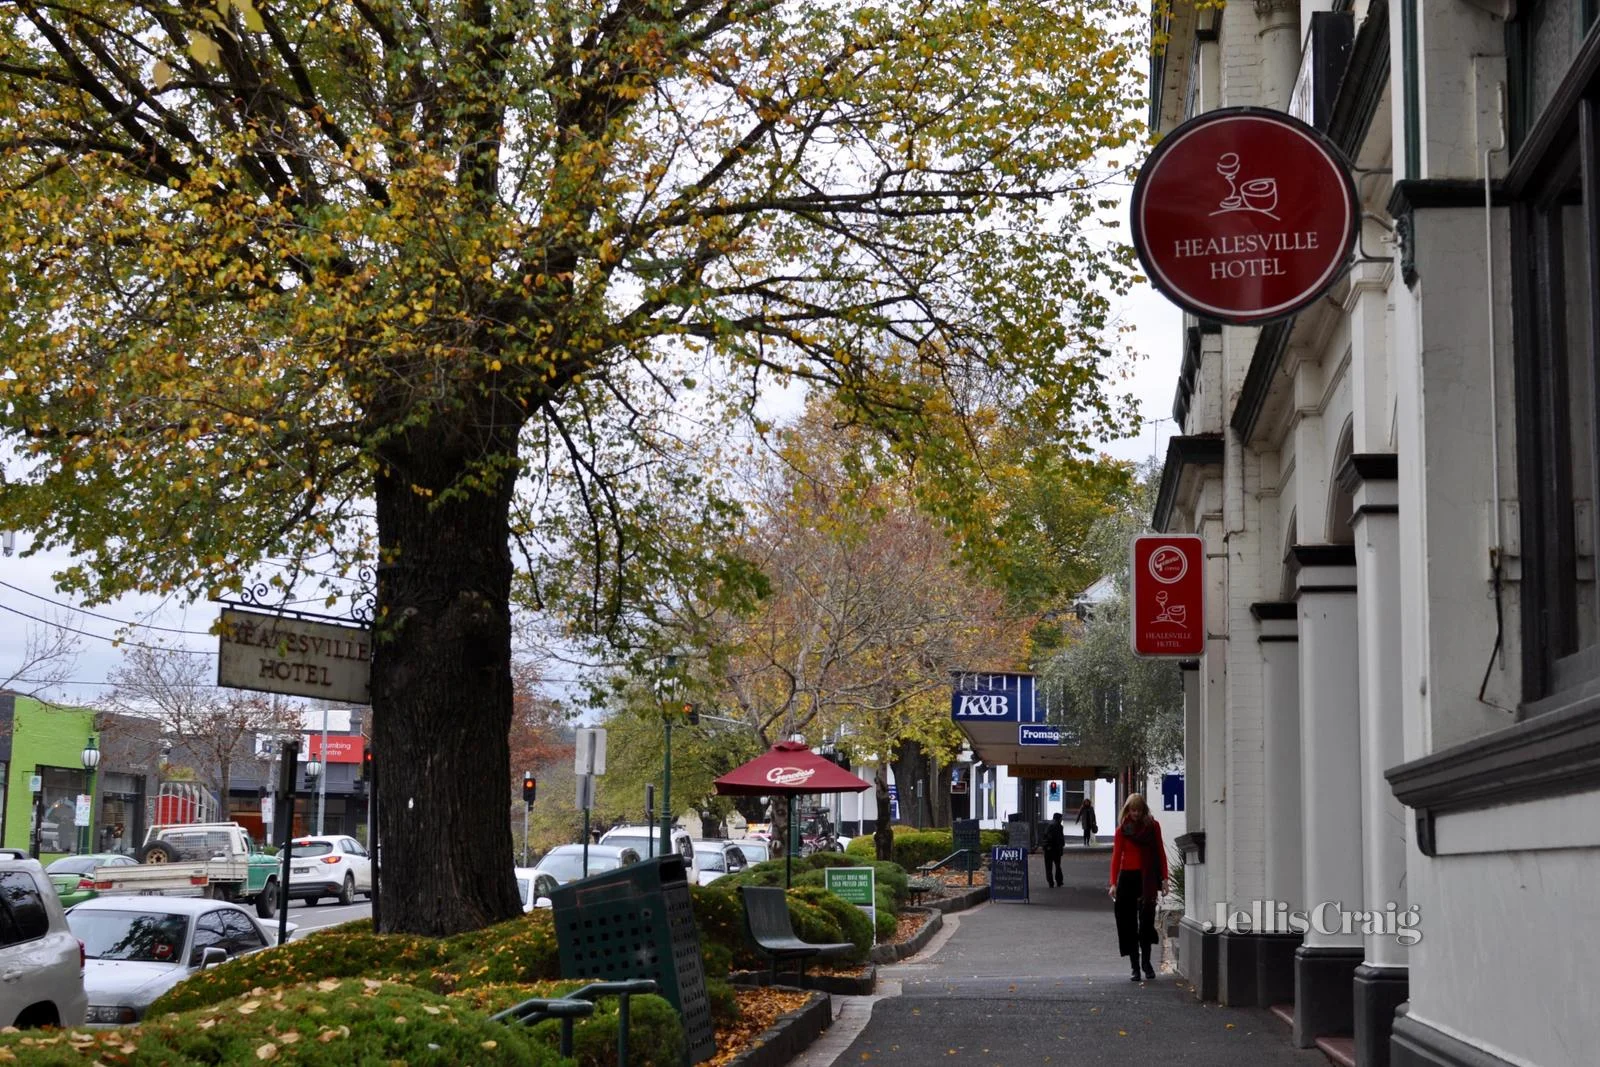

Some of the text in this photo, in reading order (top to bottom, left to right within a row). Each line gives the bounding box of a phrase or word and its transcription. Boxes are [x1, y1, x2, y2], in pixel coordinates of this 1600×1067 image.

[1174, 232, 1319, 258] HEALESVILLE
[1210, 258, 1286, 279] HOTEL
[1145, 632, 1192, 640] HEALESVILLE
[259, 658, 332, 686] HOTEL
[956, 695, 1009, 716] K&B
[1023, 729, 1076, 741] Fromag
[319, 742, 351, 750] pumbing
[156, 944, 169, 955] P
